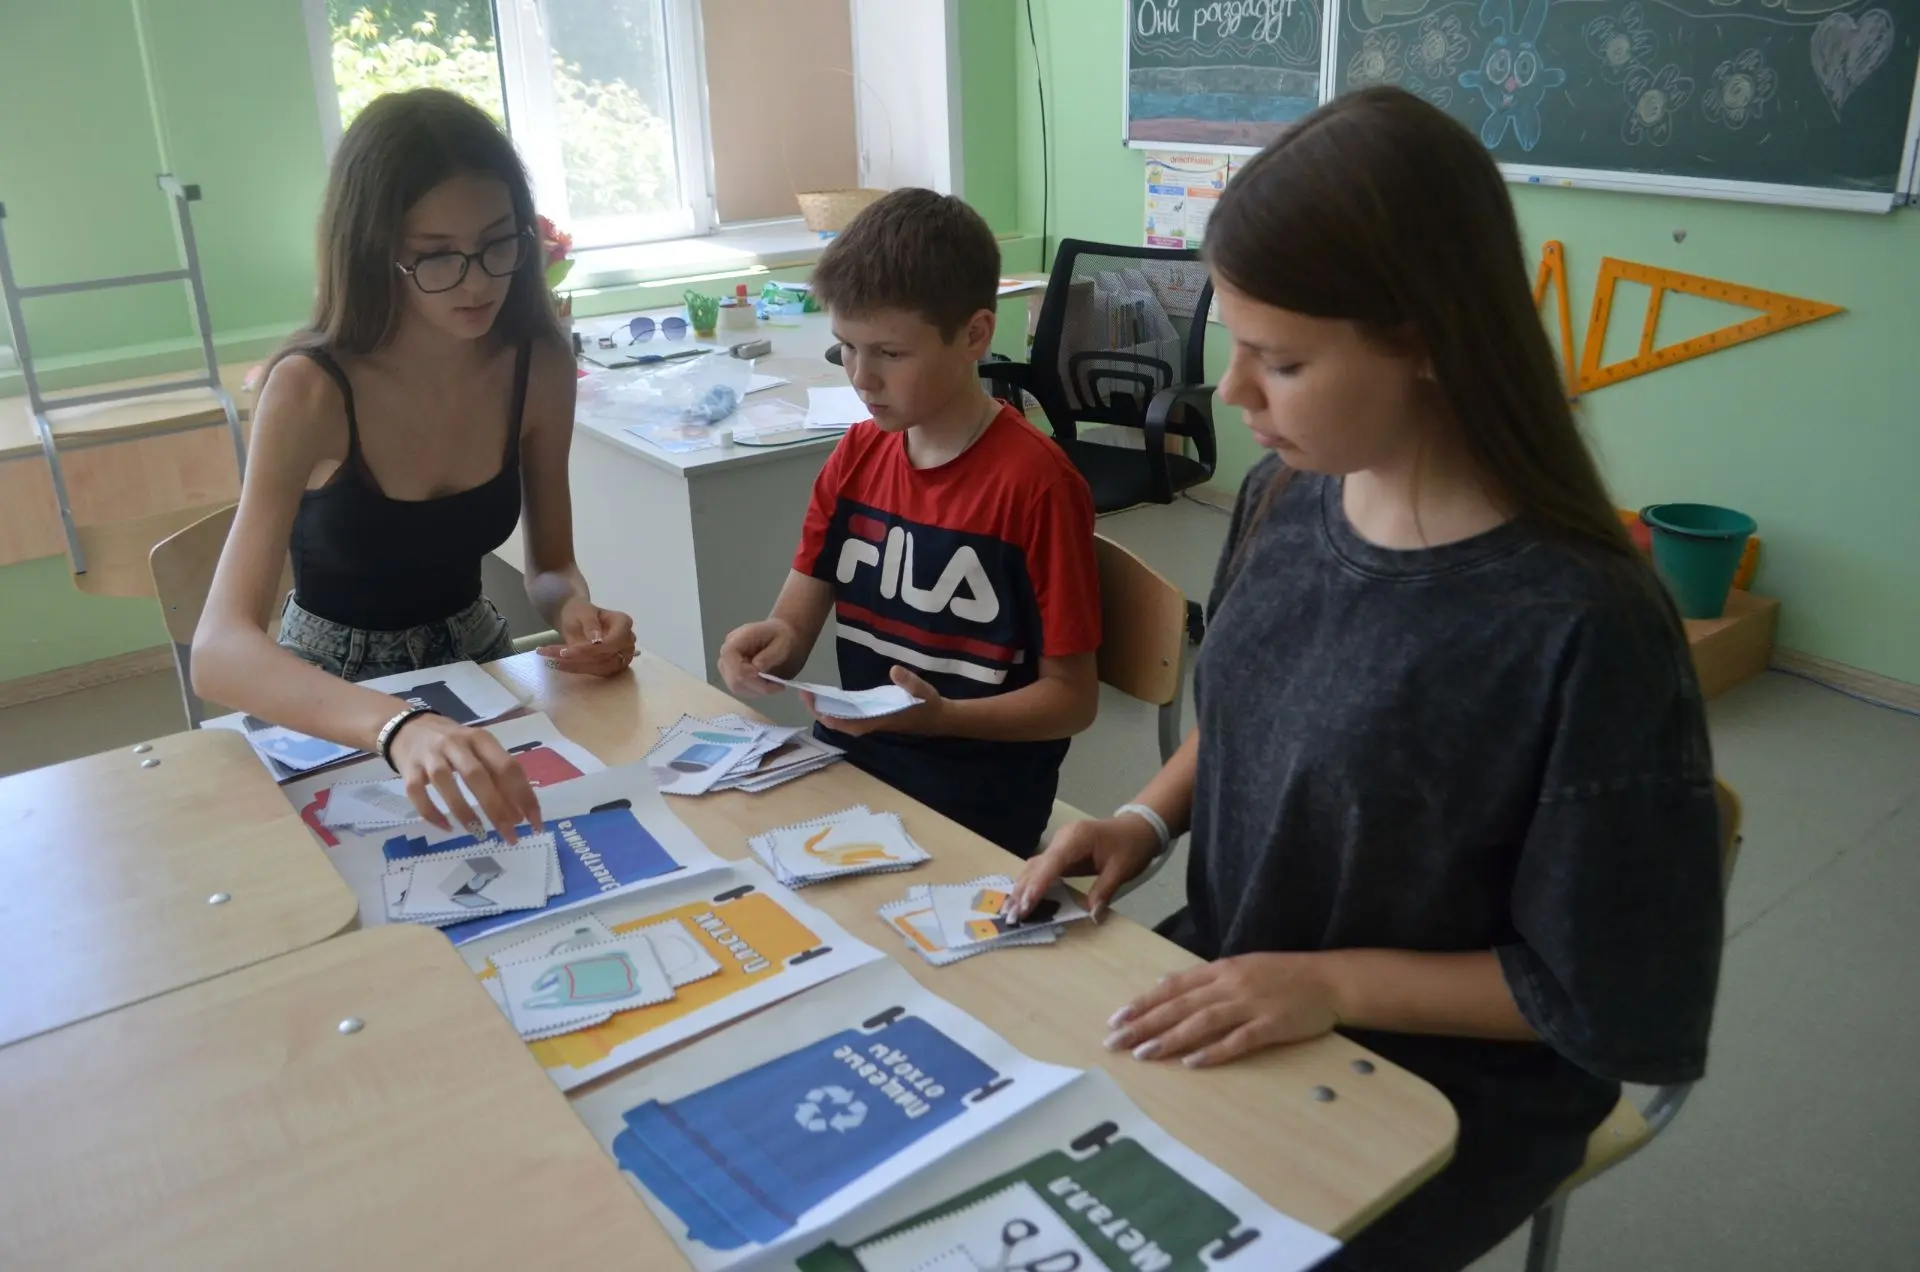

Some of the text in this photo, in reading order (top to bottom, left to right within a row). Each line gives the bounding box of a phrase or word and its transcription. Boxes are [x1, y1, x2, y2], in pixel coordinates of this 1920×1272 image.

[1192, 0, 1297, 43] раздадут
[835, 514, 1000, 624] FILA
[557, 819, 621, 892] Электроника
[691, 911, 771, 974] Пластик
[832, 1043, 931, 1119] Пищевые
[867, 1042, 946, 1098] отходы
[1046, 1175, 1173, 1272] Металл
